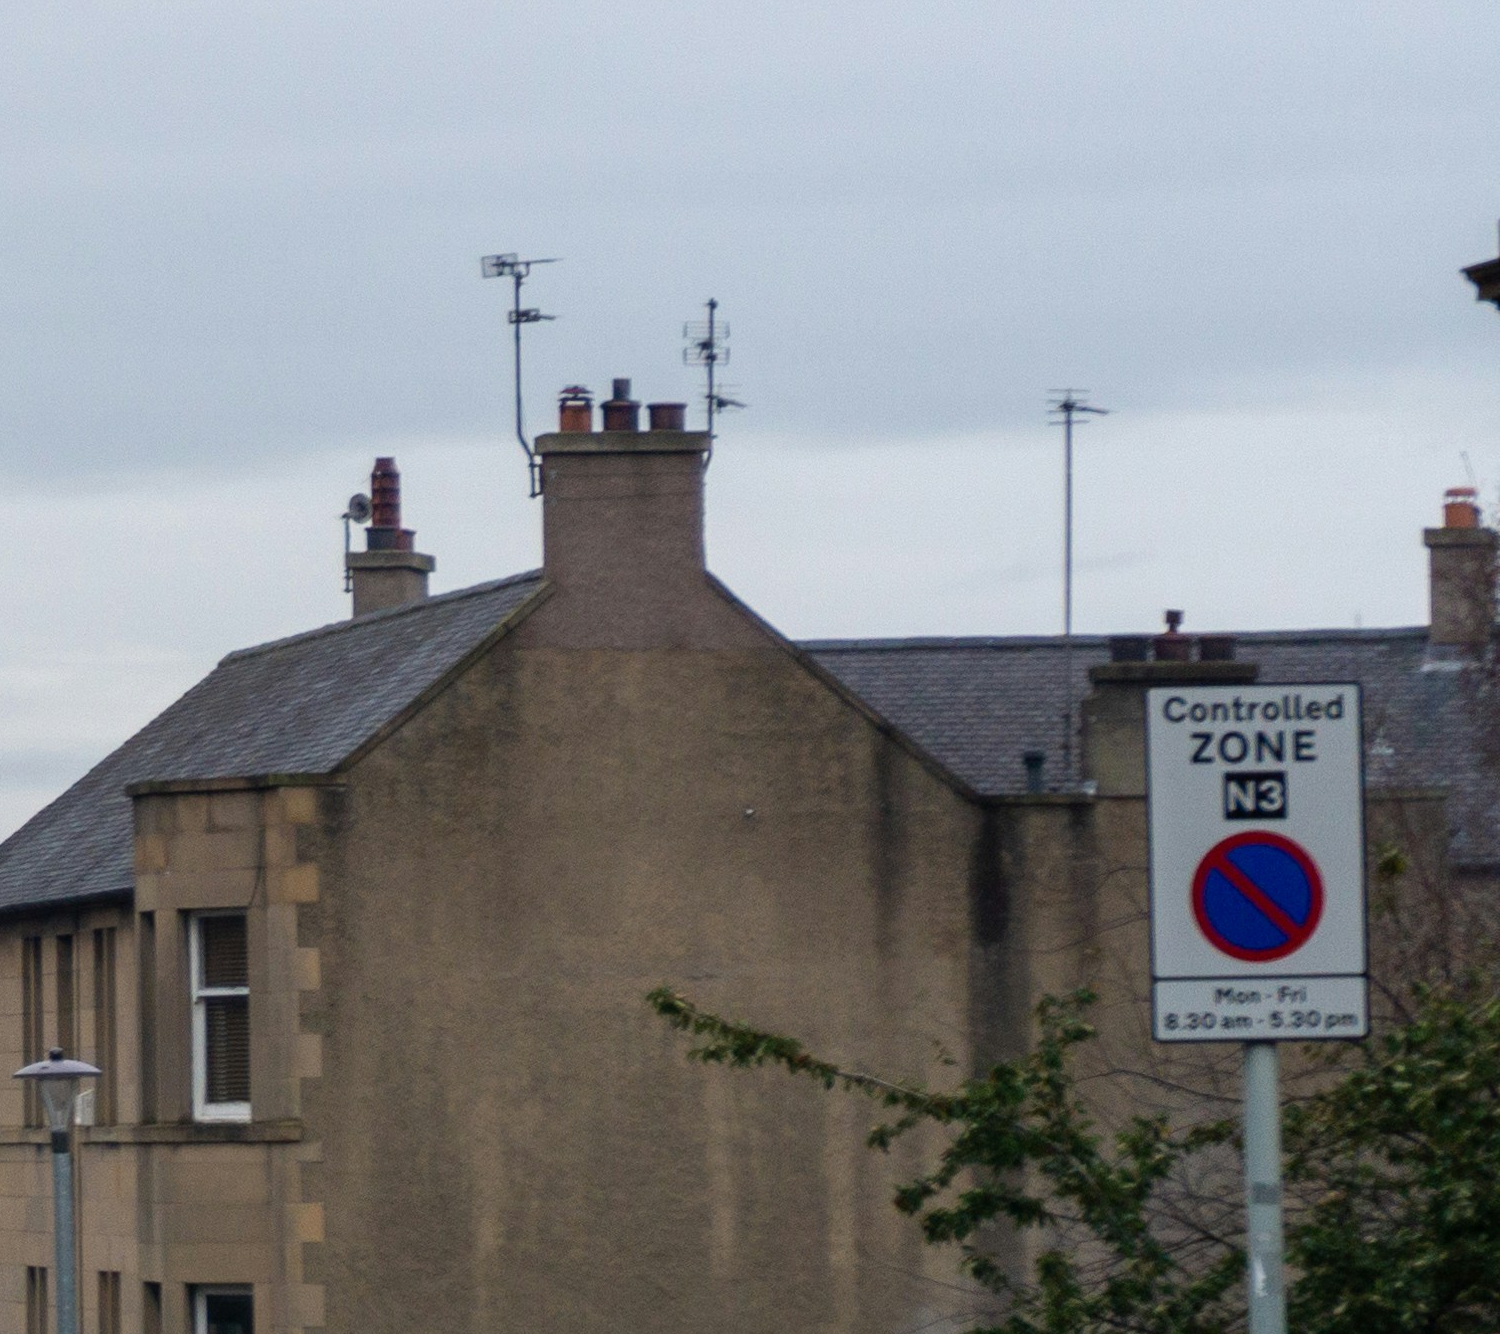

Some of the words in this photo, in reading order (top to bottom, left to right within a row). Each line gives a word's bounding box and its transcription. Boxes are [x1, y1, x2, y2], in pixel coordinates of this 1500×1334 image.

[1163, 694, 1344, 723] Controlled
[1189, 730, 1318, 764] ZONE
[1227, 780, 1284, 812] N3
[1214, 987, 1262, 1005] Mon
[1277, 985, 1307, 1003] Fri
[1163, 1012, 1217, 1031] 8.30
[1221, 1015, 1254, 1030] am
[1268, 1010, 1320, 1029] 5.30
[1324, 1012, 1359, 1031] pm
